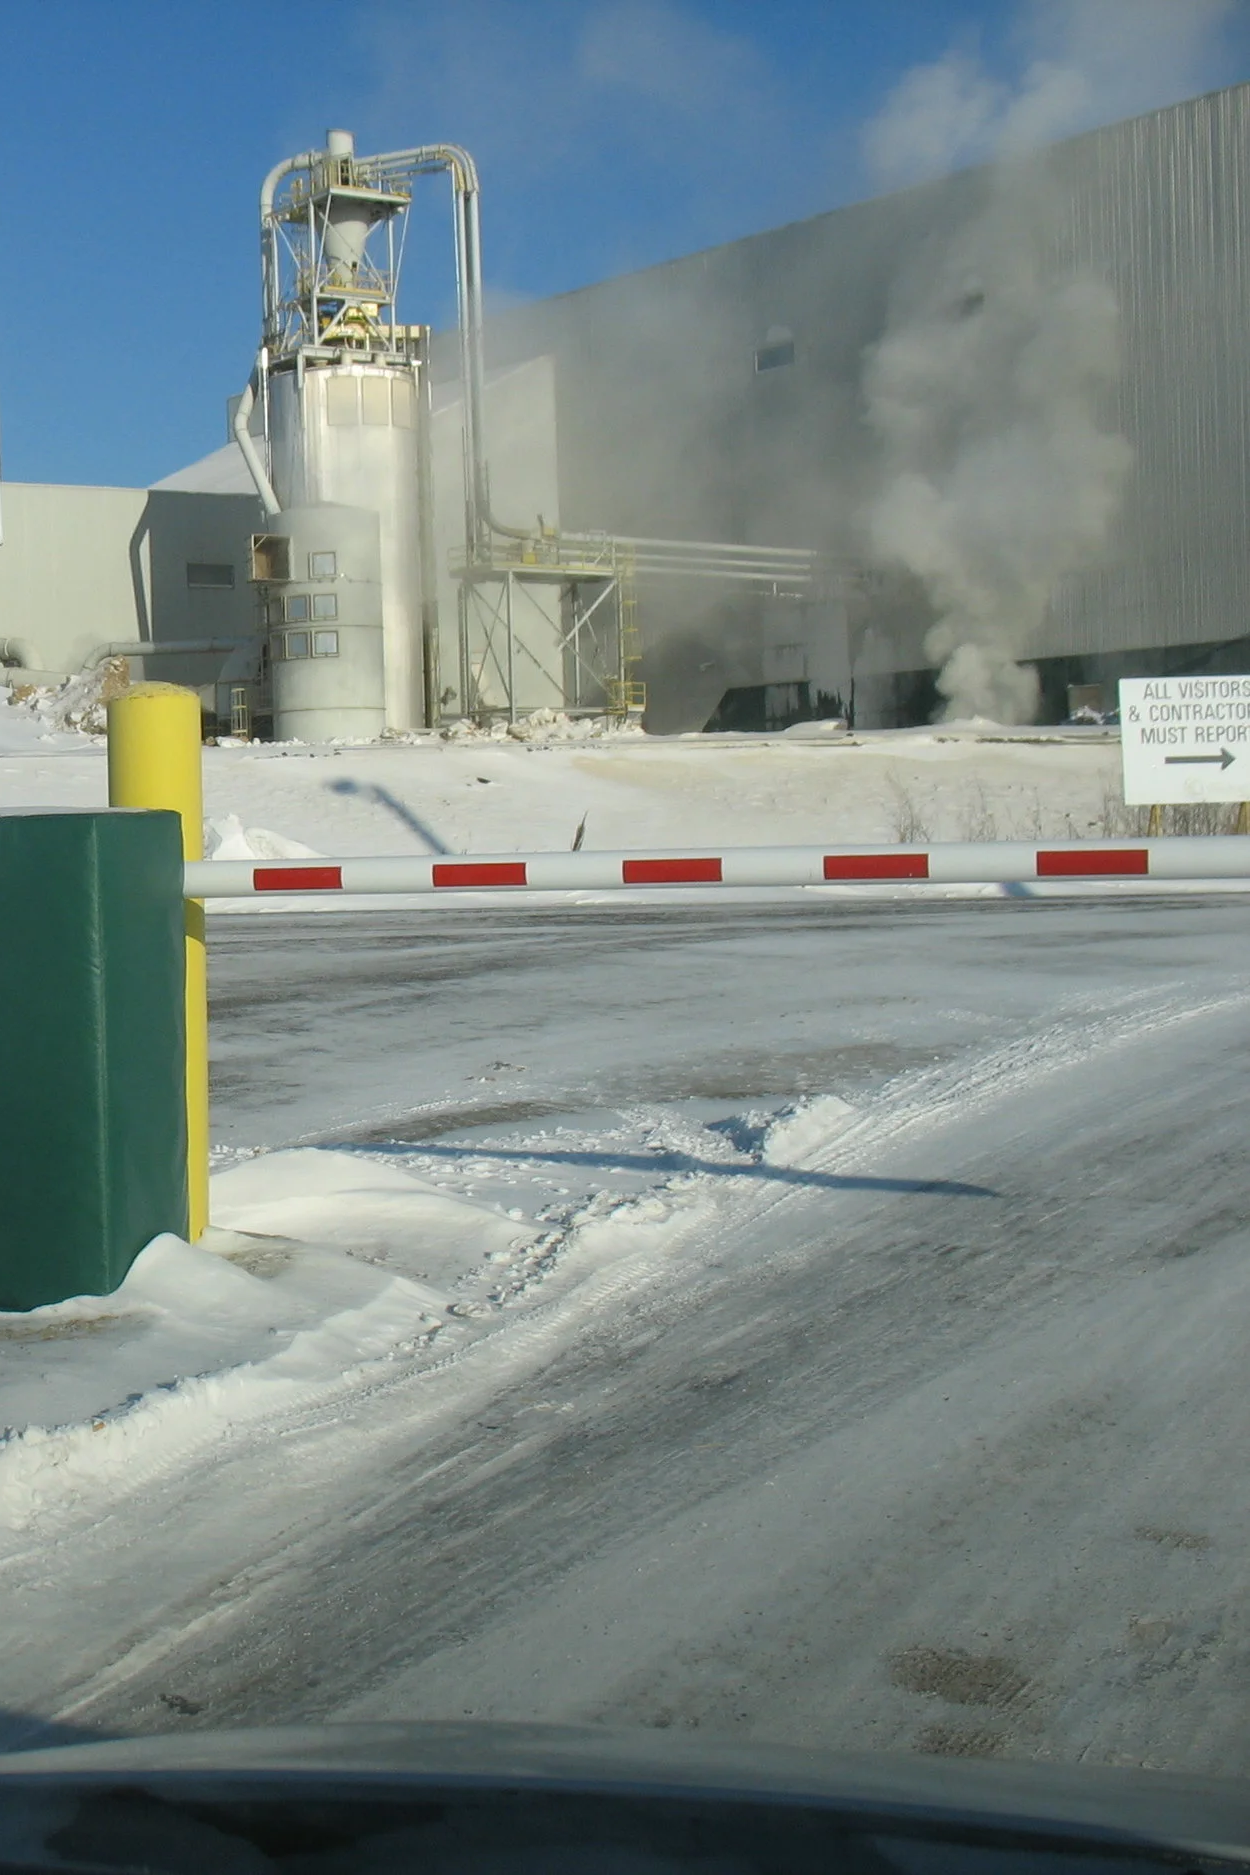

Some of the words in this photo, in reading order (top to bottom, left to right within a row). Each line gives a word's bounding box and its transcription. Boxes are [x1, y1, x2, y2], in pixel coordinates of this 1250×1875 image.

[1144, 682, 1172, 700] ALL
[1178, 680, 1250, 700] VISITORS
[1128, 705, 1141, 722] &
[1149, 703, 1250, 722] CONTRACTO
[1140, 726, 1187, 744] MUST
